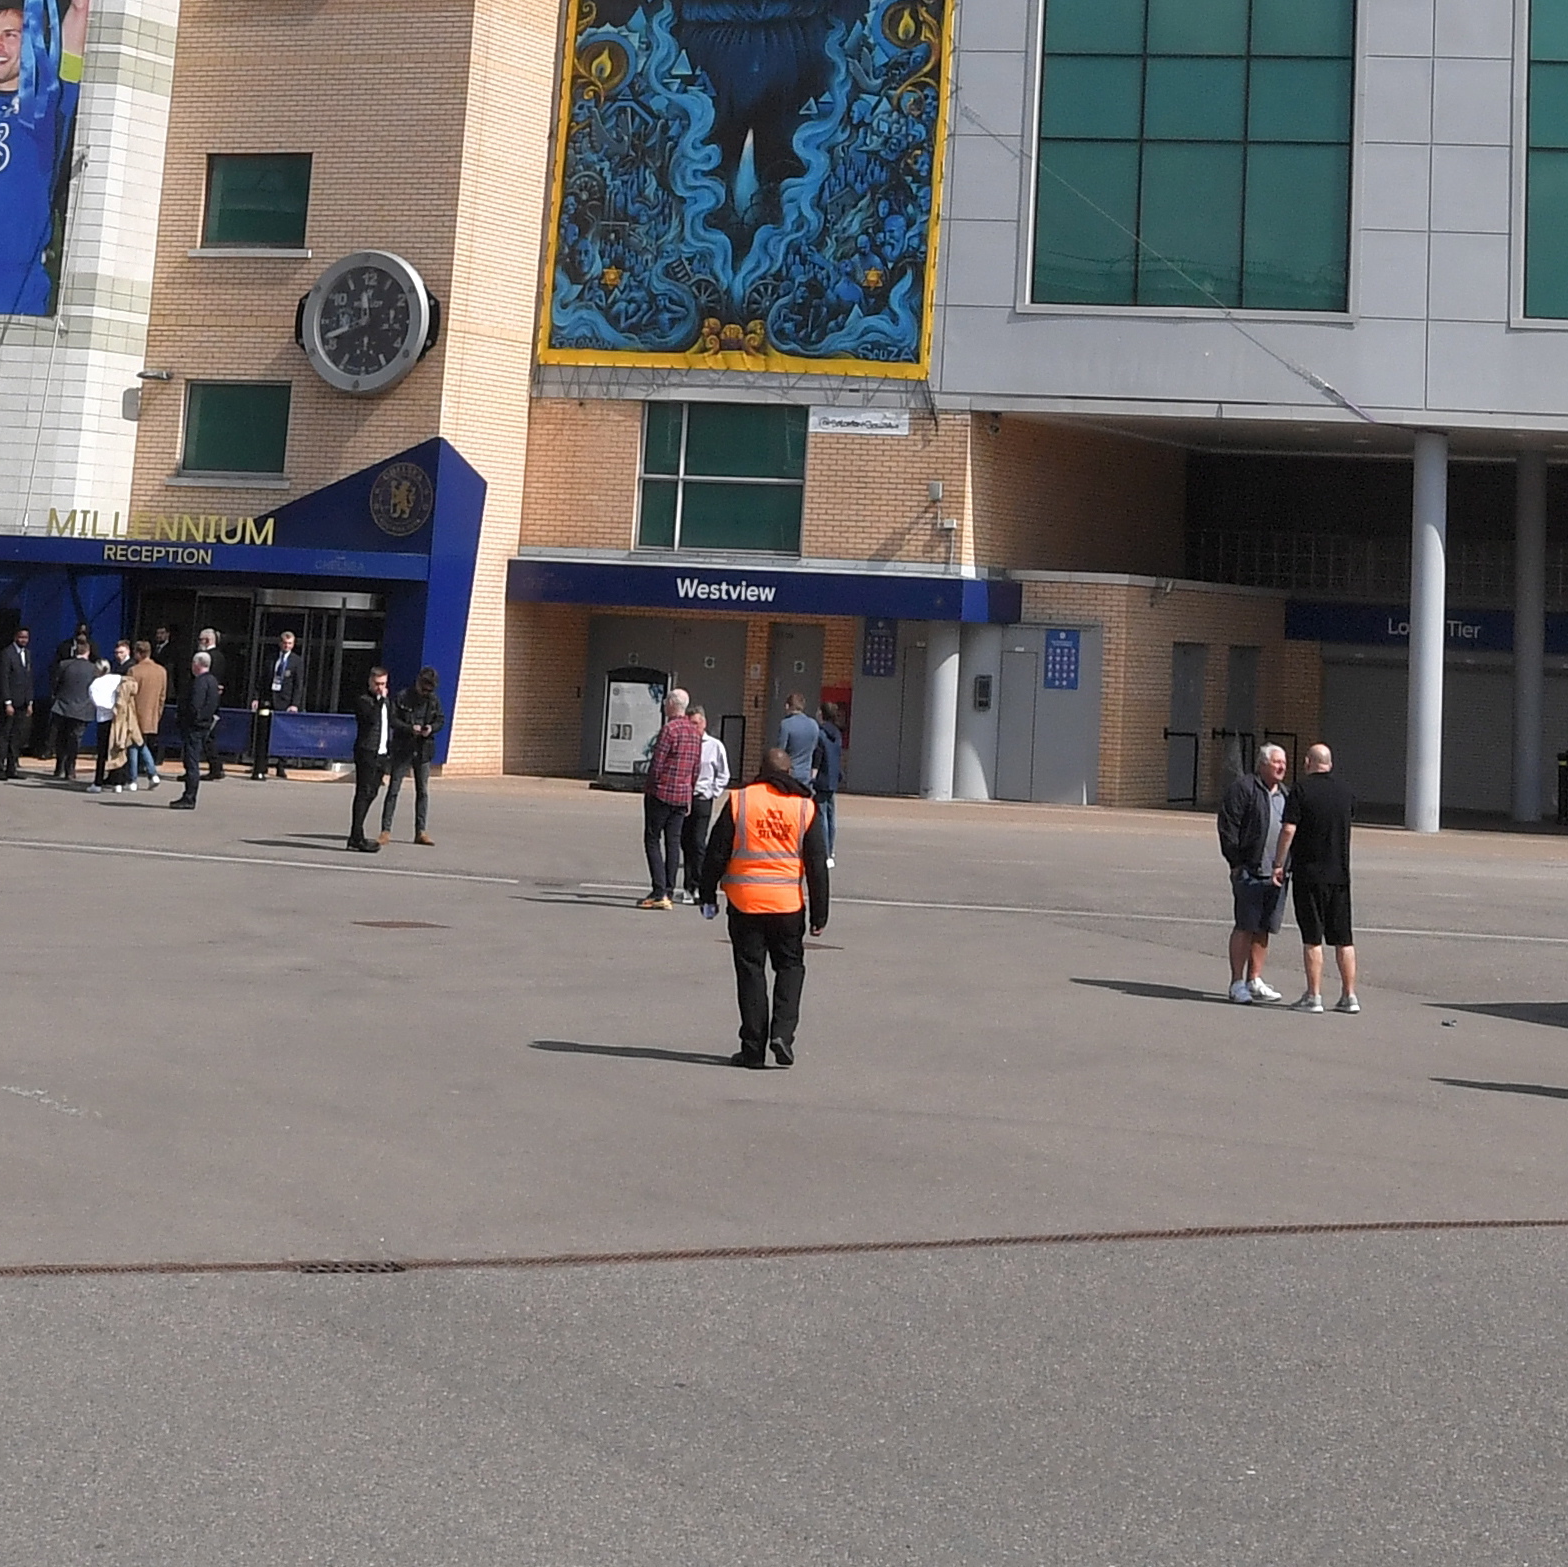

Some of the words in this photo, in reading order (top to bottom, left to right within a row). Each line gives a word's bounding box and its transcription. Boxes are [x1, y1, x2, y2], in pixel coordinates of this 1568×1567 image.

[362, 271, 378, 286] 12
[329, 292, 348, 306] 10
[397, 294, 406, 307] 2
[47, 507, 275, 546] MILLENNIUM
[102, 544, 213, 565] RECEPTION
[676, 577, 776, 602] Westview
[1446, 619, 1481, 639] Tier
